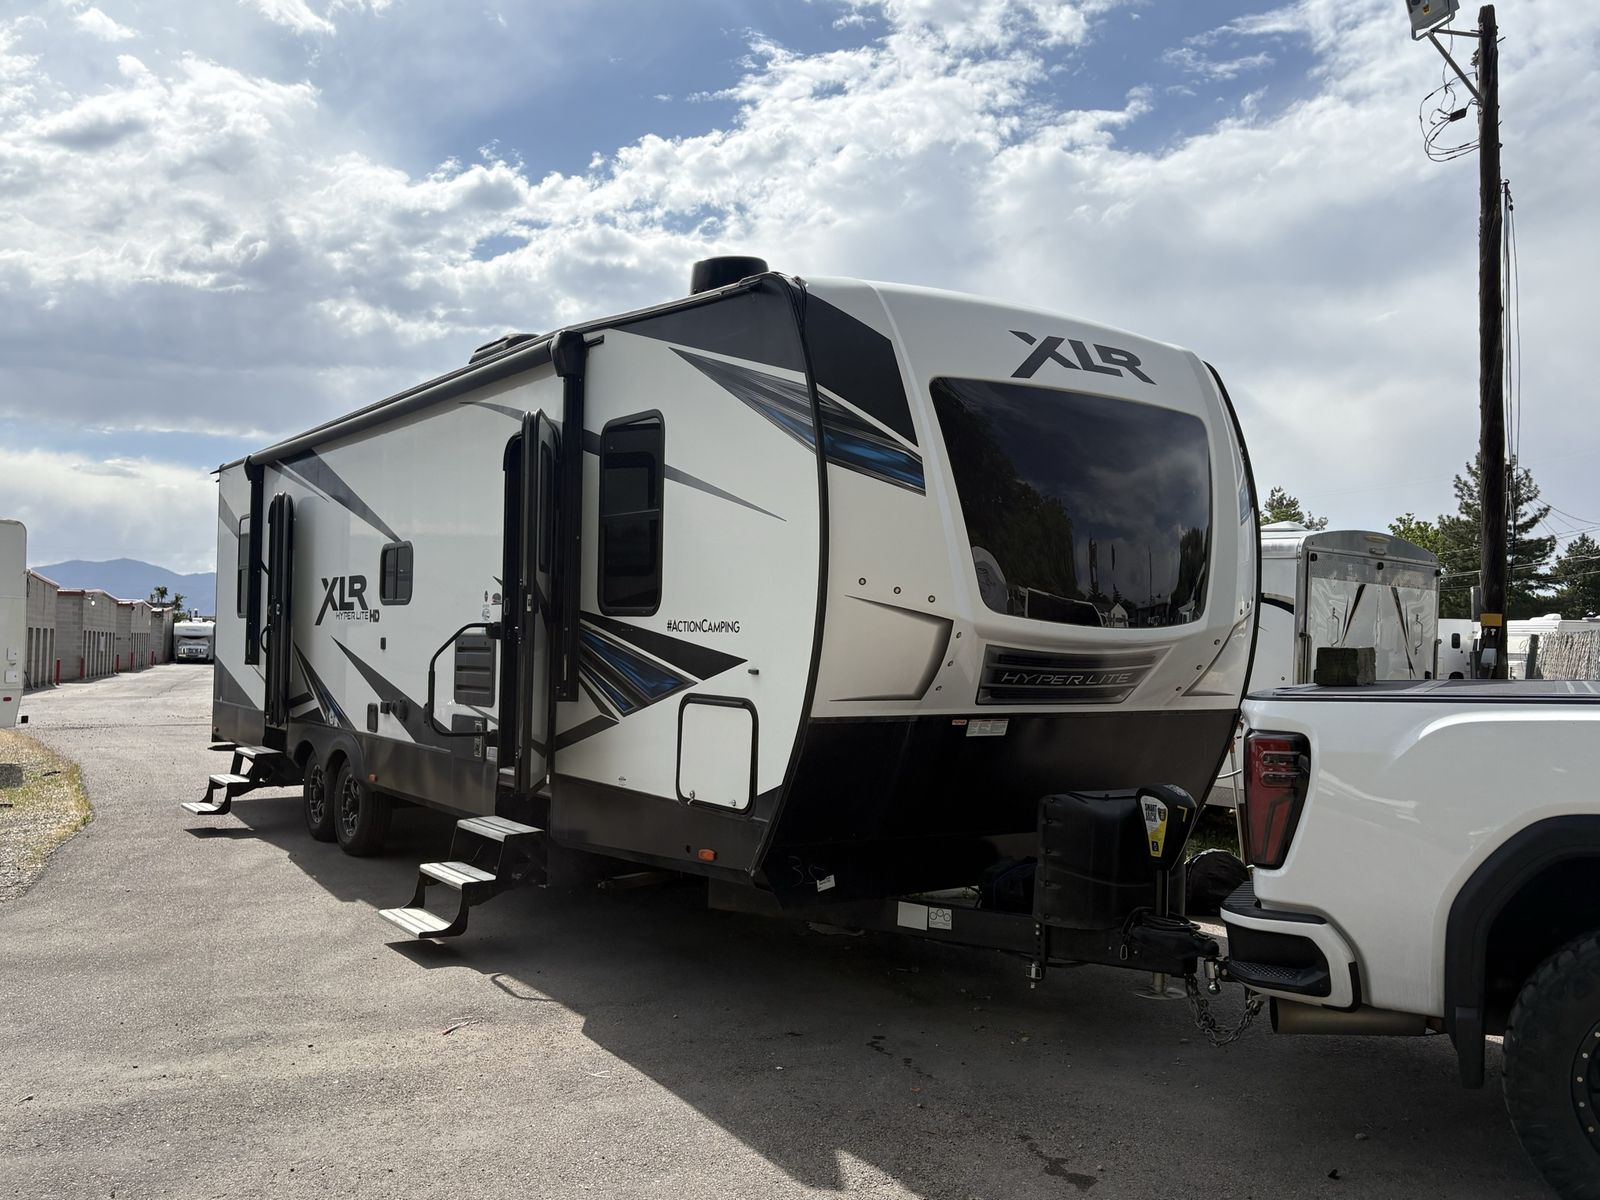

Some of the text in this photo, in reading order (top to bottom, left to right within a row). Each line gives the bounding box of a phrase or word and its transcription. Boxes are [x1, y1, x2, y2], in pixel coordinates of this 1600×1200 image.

[1008, 329, 1157, 386] XLR
[314, 574, 369, 626] XLR
[369, 609, 380, 623] HD
[1001, 672, 1134, 685] HYPER LITE
